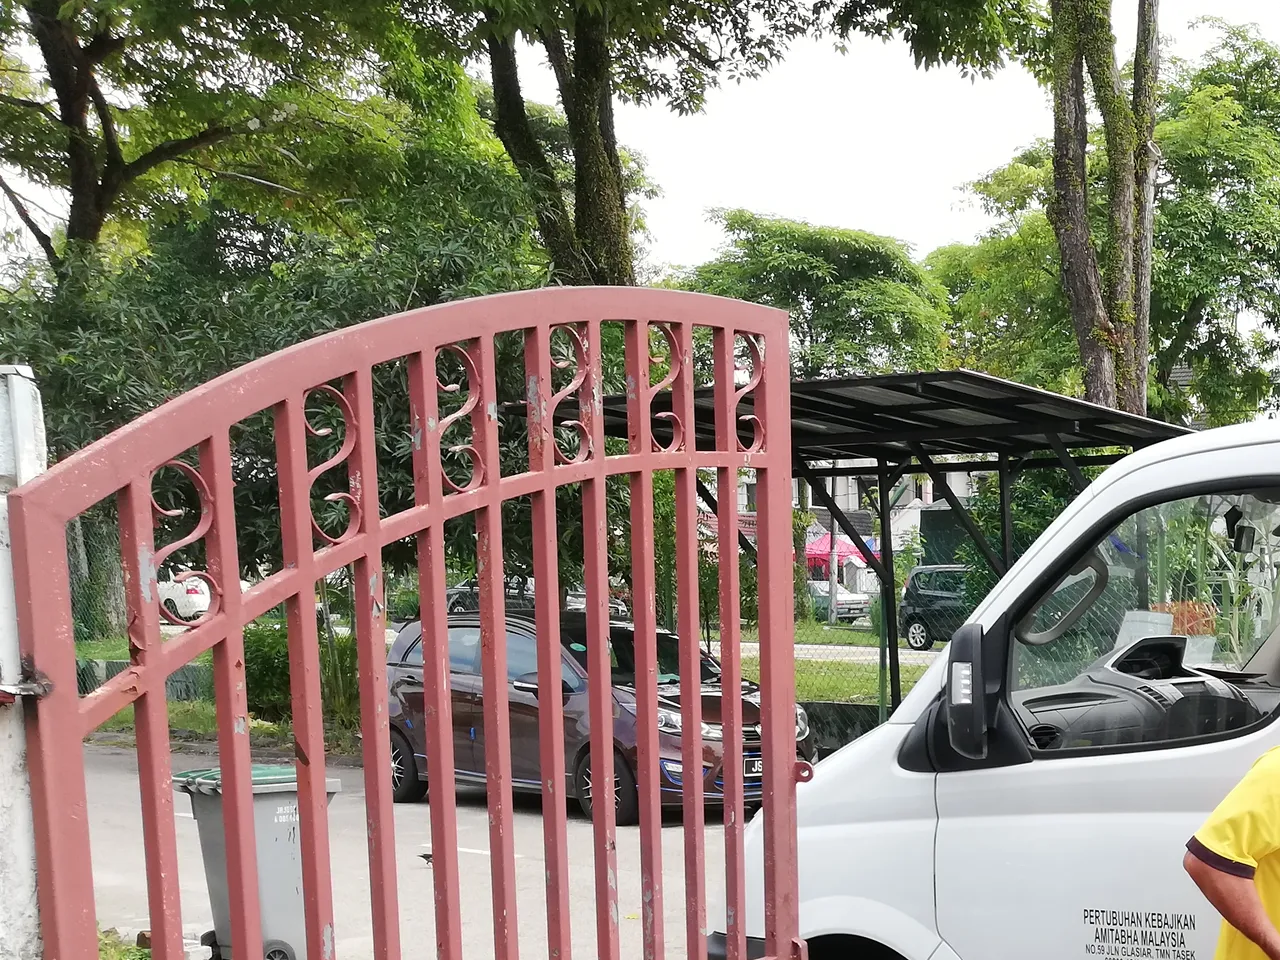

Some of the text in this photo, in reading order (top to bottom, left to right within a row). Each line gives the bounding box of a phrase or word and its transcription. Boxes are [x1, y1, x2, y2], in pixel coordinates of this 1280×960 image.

[1083, 909, 1196, 930] PERTUBUHAN KEBAJIKAN
[1094, 927, 1186, 948] AMITABHA MALAYSIA
[1106, 945, 1119, 956] JLN
[1155, 948, 1170, 959] TMN
[1172, 949, 1196, 960] TASEK
